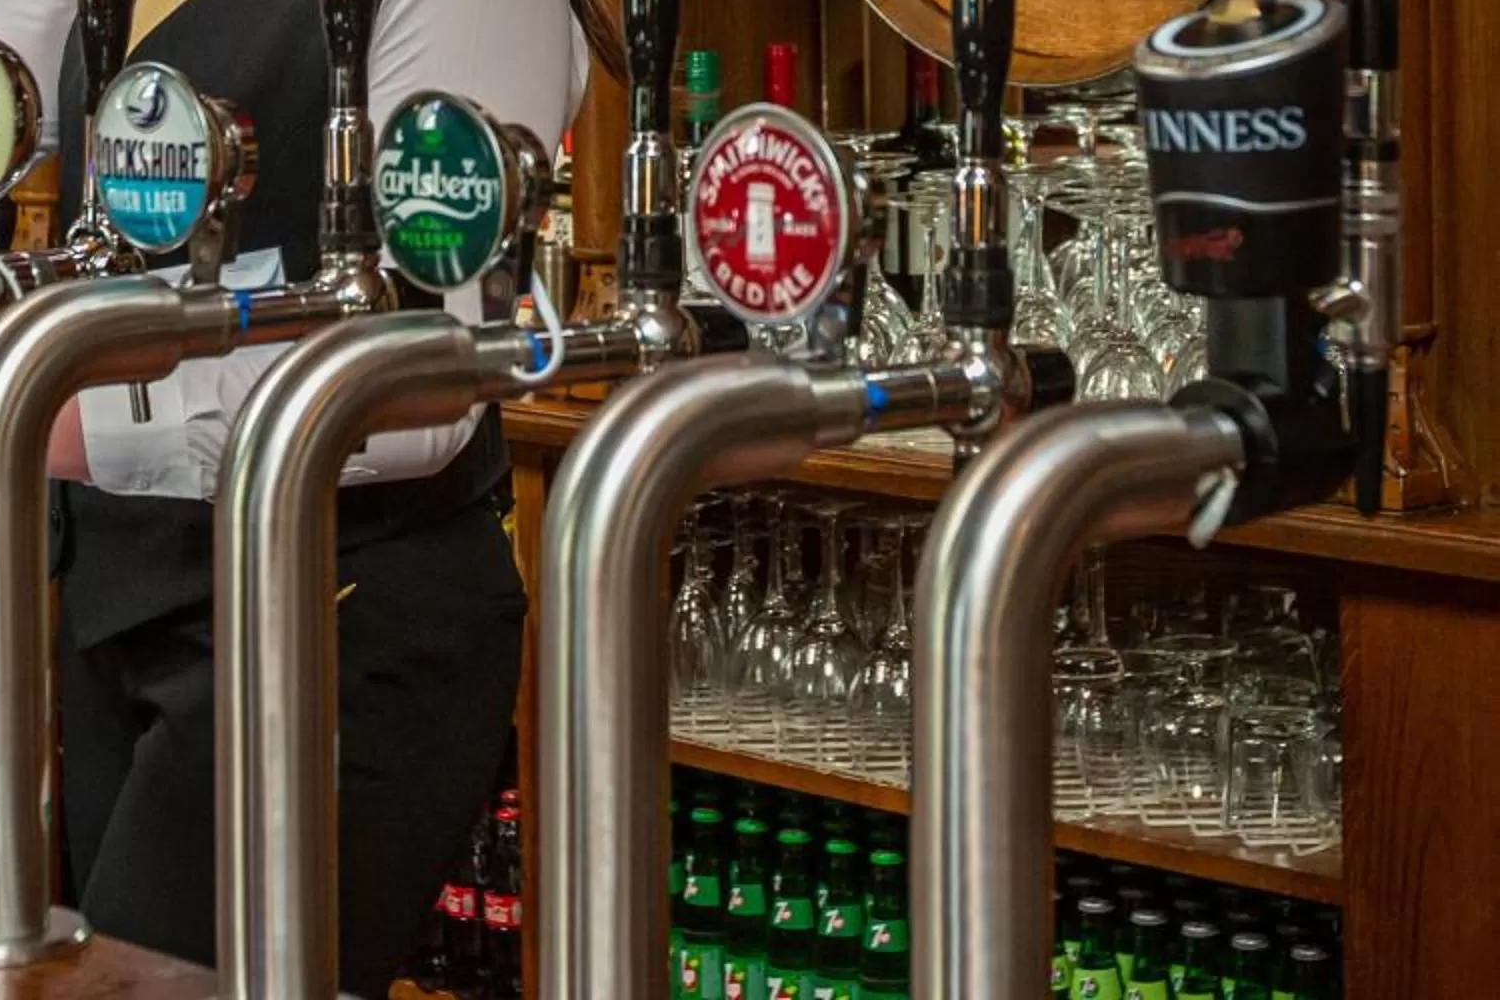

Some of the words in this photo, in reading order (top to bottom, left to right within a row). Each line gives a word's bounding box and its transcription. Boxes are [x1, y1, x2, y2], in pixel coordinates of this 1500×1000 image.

[1143, 105, 1307, 153] INNESS
[375, 150, 497, 213] Carlsberg
[716, 260, 765, 307] RED
